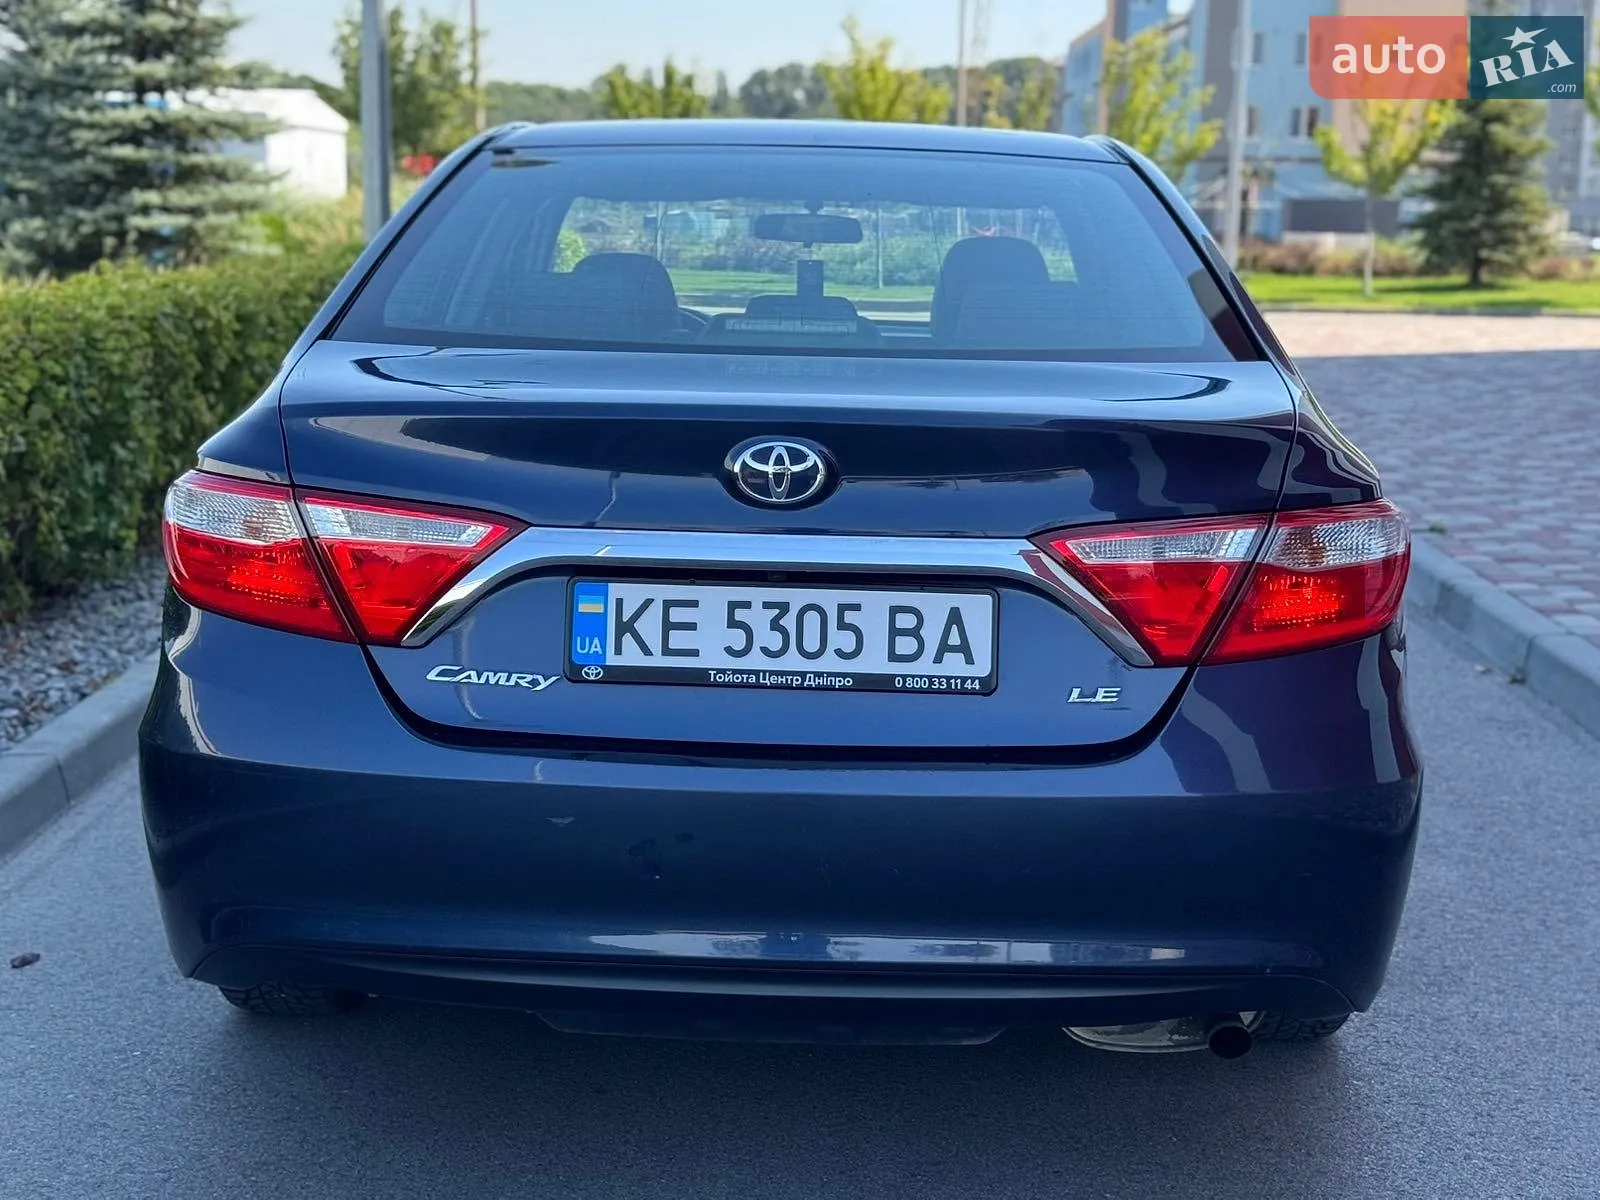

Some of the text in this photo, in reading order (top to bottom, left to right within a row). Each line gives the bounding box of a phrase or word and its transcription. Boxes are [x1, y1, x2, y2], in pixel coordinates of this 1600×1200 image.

[613, 597, 975, 665] KE 5305 BA
[576, 636, 602, 654] UA
[426, 665, 561, 691] CAMRY
[708, 670, 853, 688] Тойота Центр Дніпро
[895, 677, 980, 690] 0 800 33 11 44
[1067, 687, 1121, 703] LE
